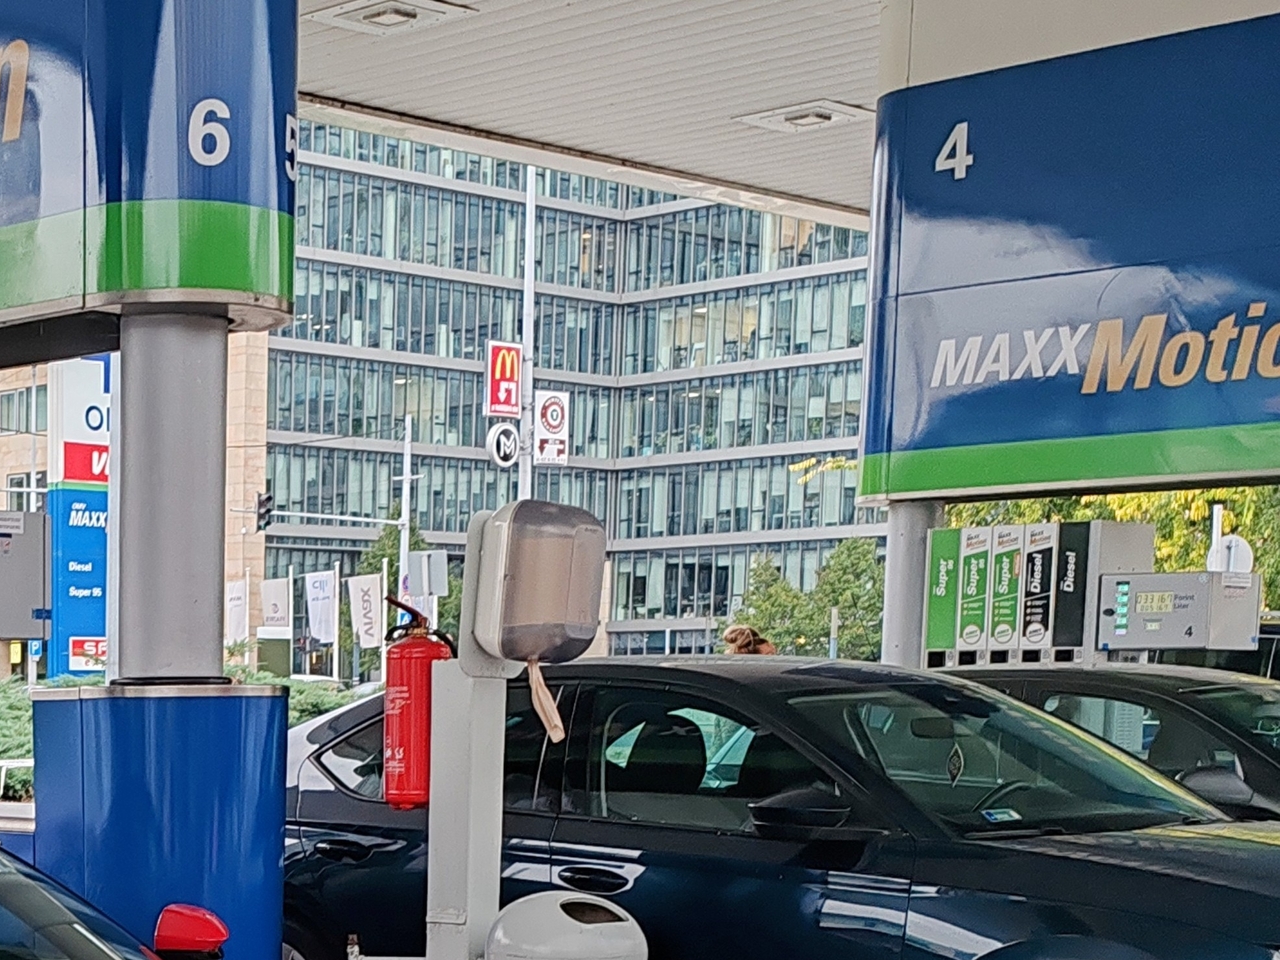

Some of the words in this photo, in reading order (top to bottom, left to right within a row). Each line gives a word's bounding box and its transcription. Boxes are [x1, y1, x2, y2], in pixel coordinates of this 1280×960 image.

[188, 98, 231, 167] 6
[934, 121, 974, 180] 4
[68, 510, 107, 528] MAXX
[68, 561, 93, 572] Diesel
[936, 558, 949, 597] Super
[966, 558, 980, 596] Super
[998, 556, 1011, 595] Super
[1030, 553, 1043, 593] Diesel
[1063, 551, 1076, 593] Diesel
[68, 586, 91, 599] Super
[91, 587, 103, 597] 95
[1184, 625, 1194, 638] 4
